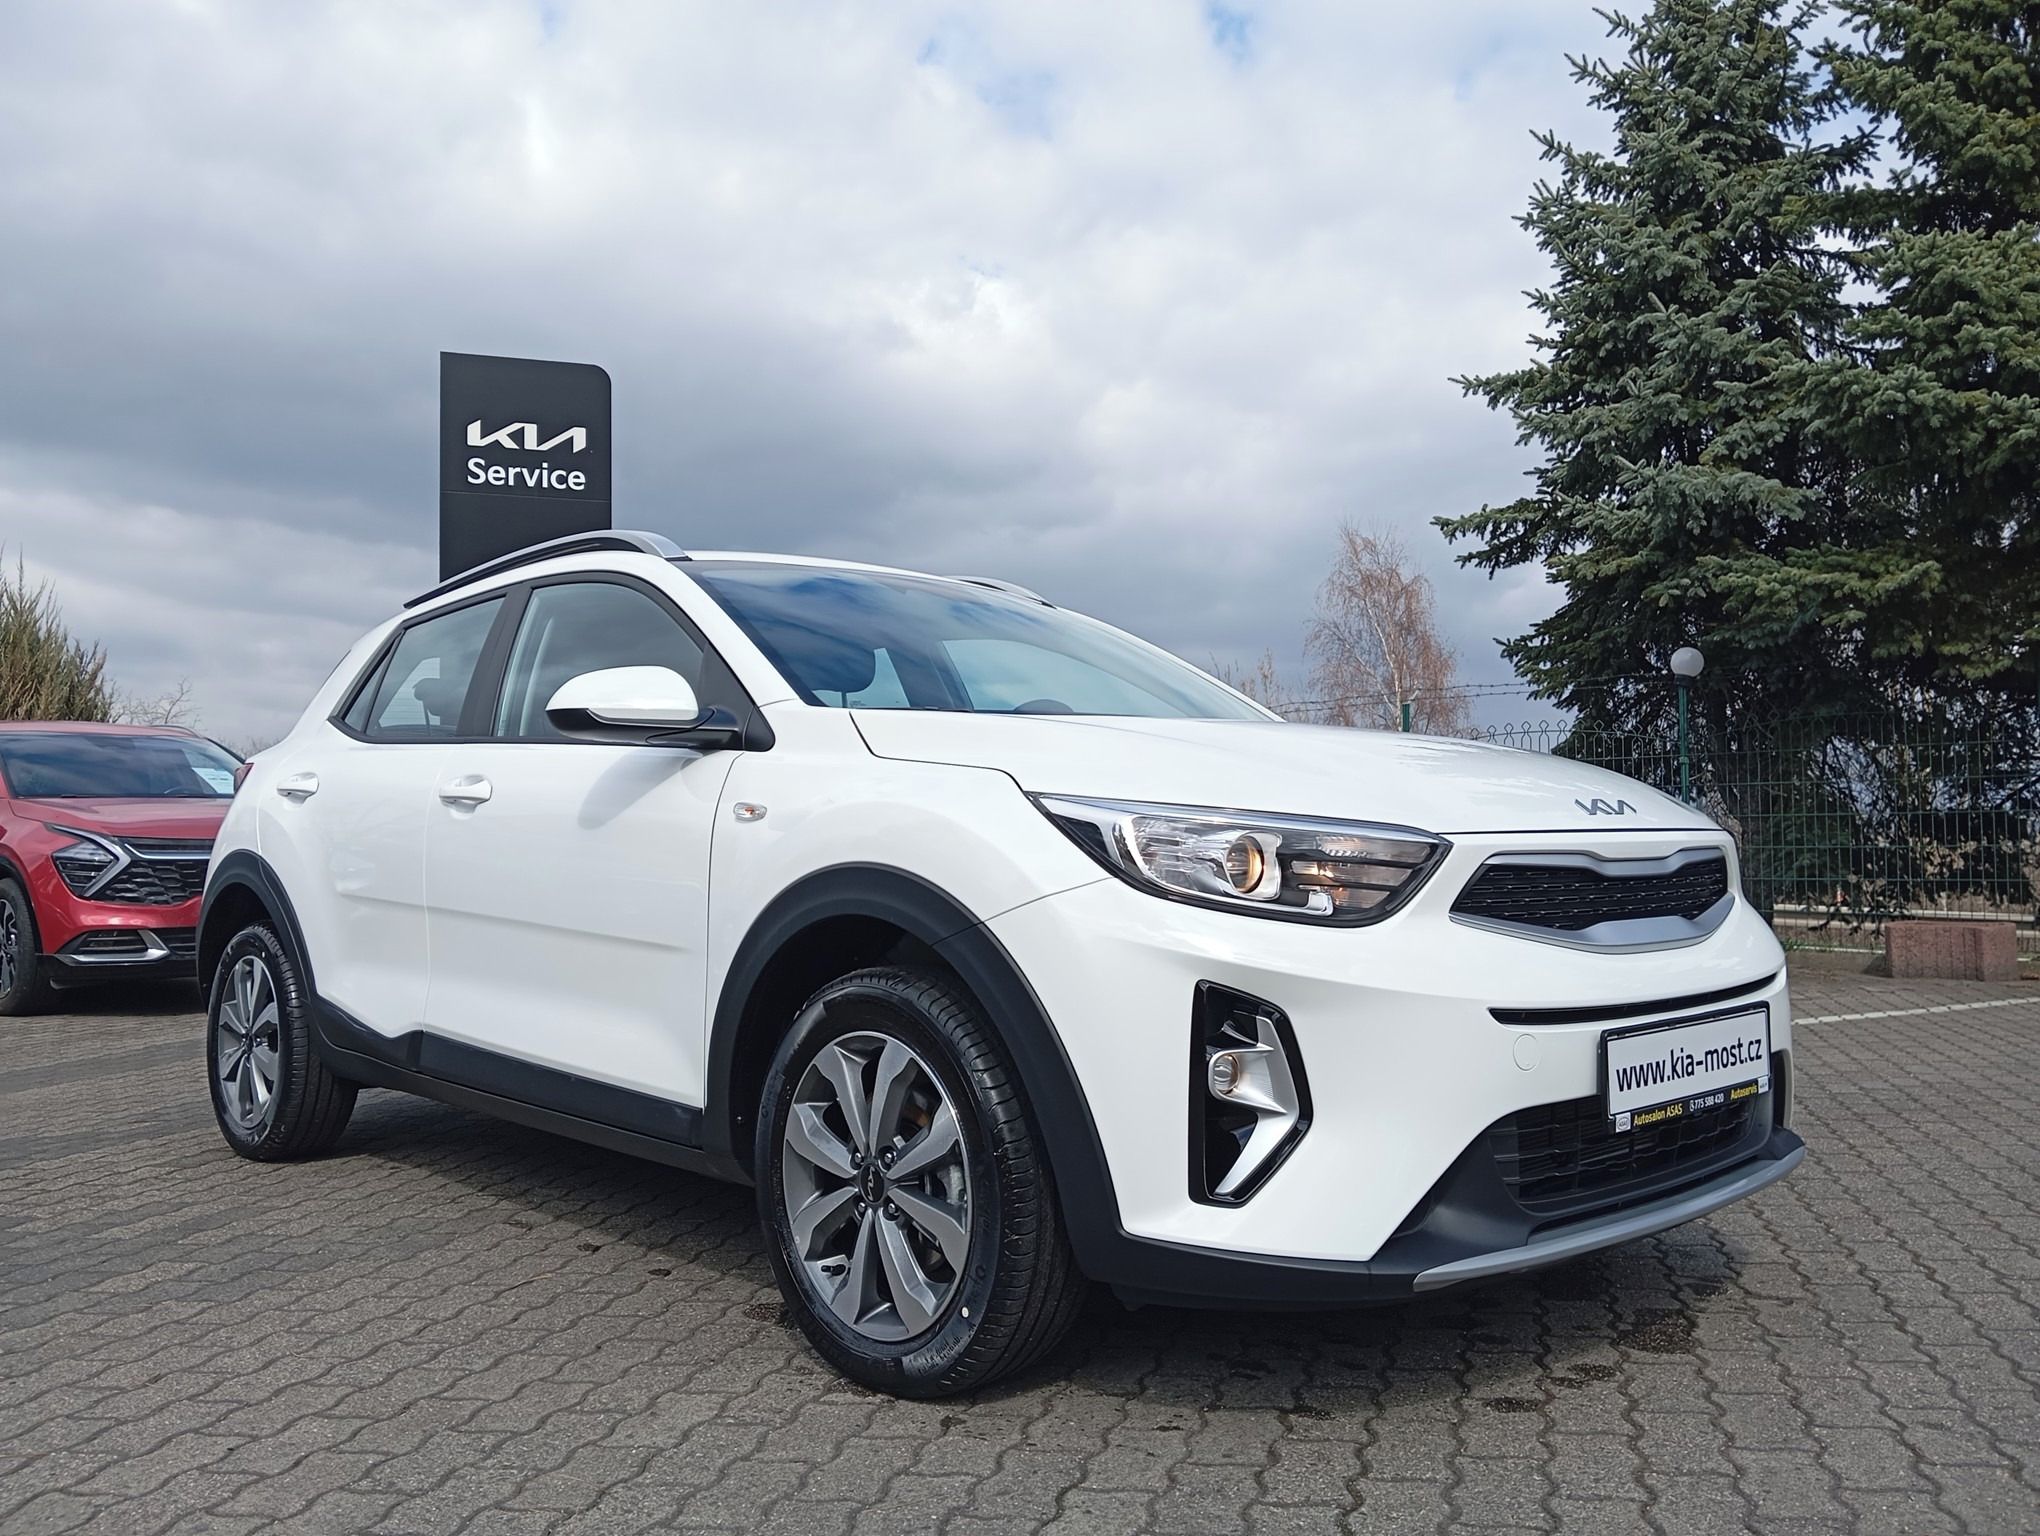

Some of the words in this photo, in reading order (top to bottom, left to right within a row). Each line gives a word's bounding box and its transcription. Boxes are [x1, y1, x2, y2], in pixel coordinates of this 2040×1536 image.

[467, 457, 586, 491] Service
[1616, 1037, 1763, 1092] www.kia-most.cz
[1633, 1109, 1666, 1127] Autosalon
[1666, 1103, 1683, 1118] ASAS
[1695, 1098, 1705, 1110] 775
